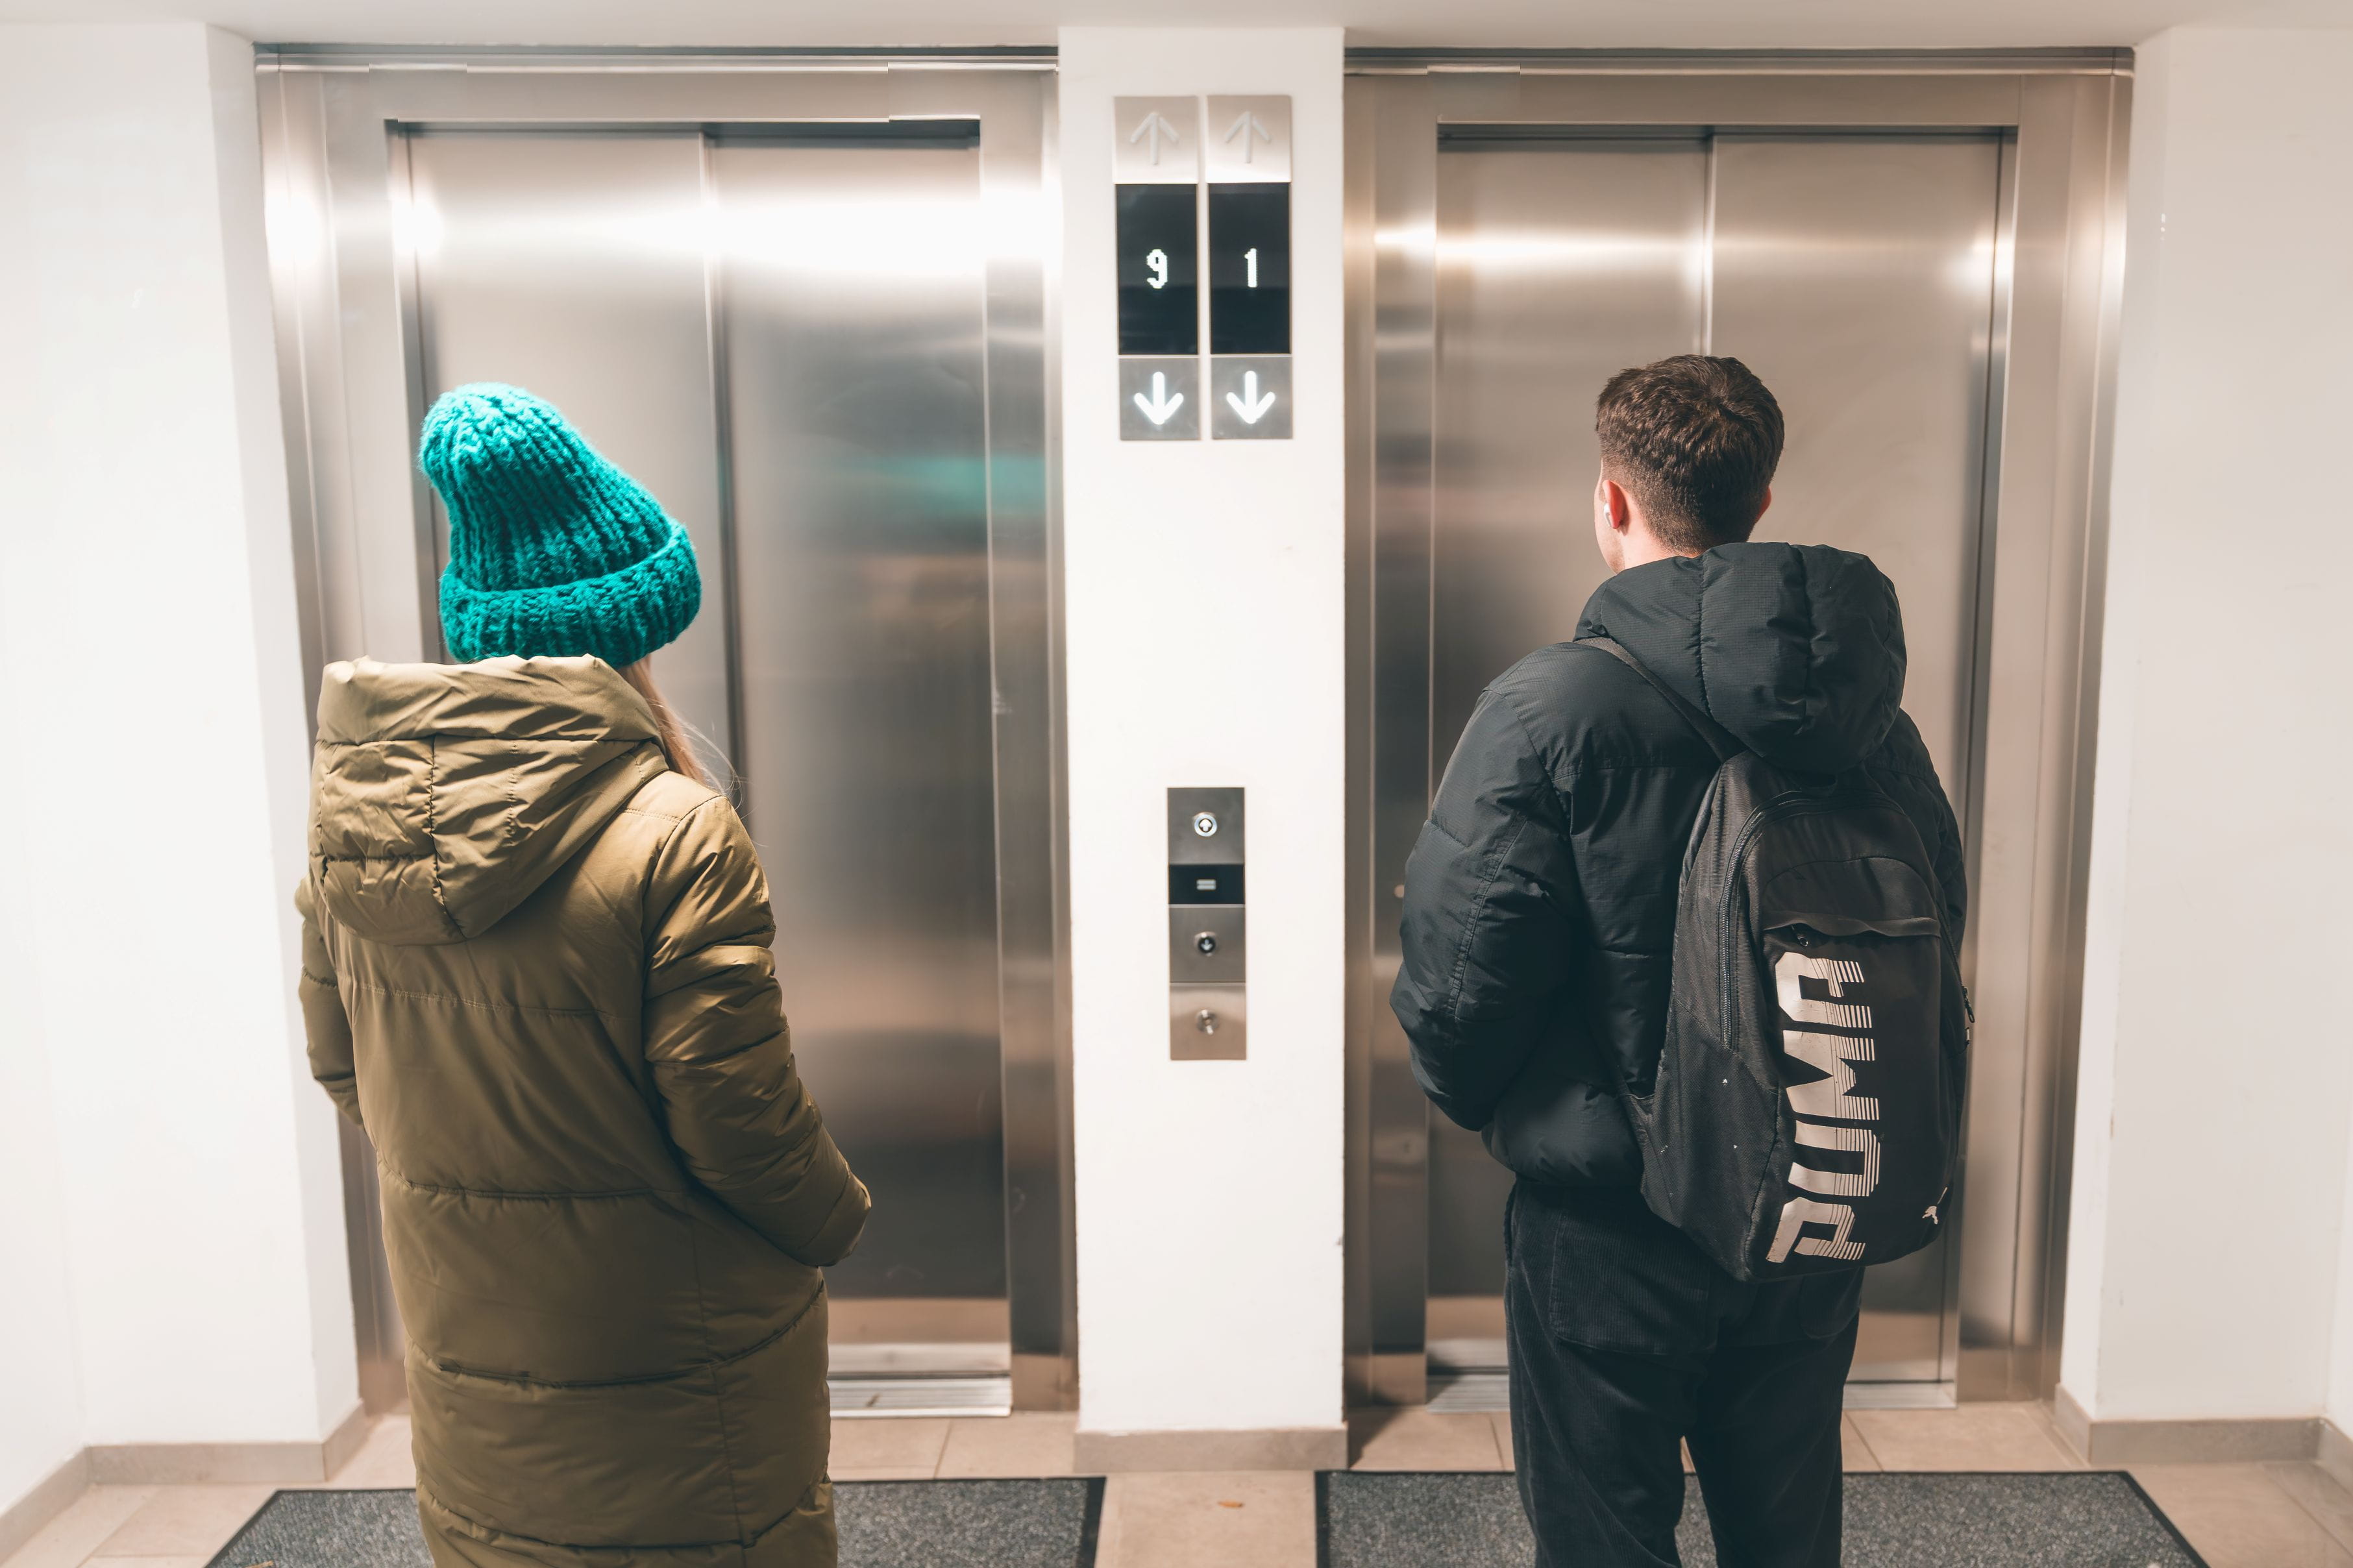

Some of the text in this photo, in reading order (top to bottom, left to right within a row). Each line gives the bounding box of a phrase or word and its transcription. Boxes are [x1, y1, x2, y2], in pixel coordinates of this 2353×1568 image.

[1146, 249, 1168, 289] 9
[1244, 248, 1257, 288] 1
[1766, 951, 1880, 1263] PUMA
